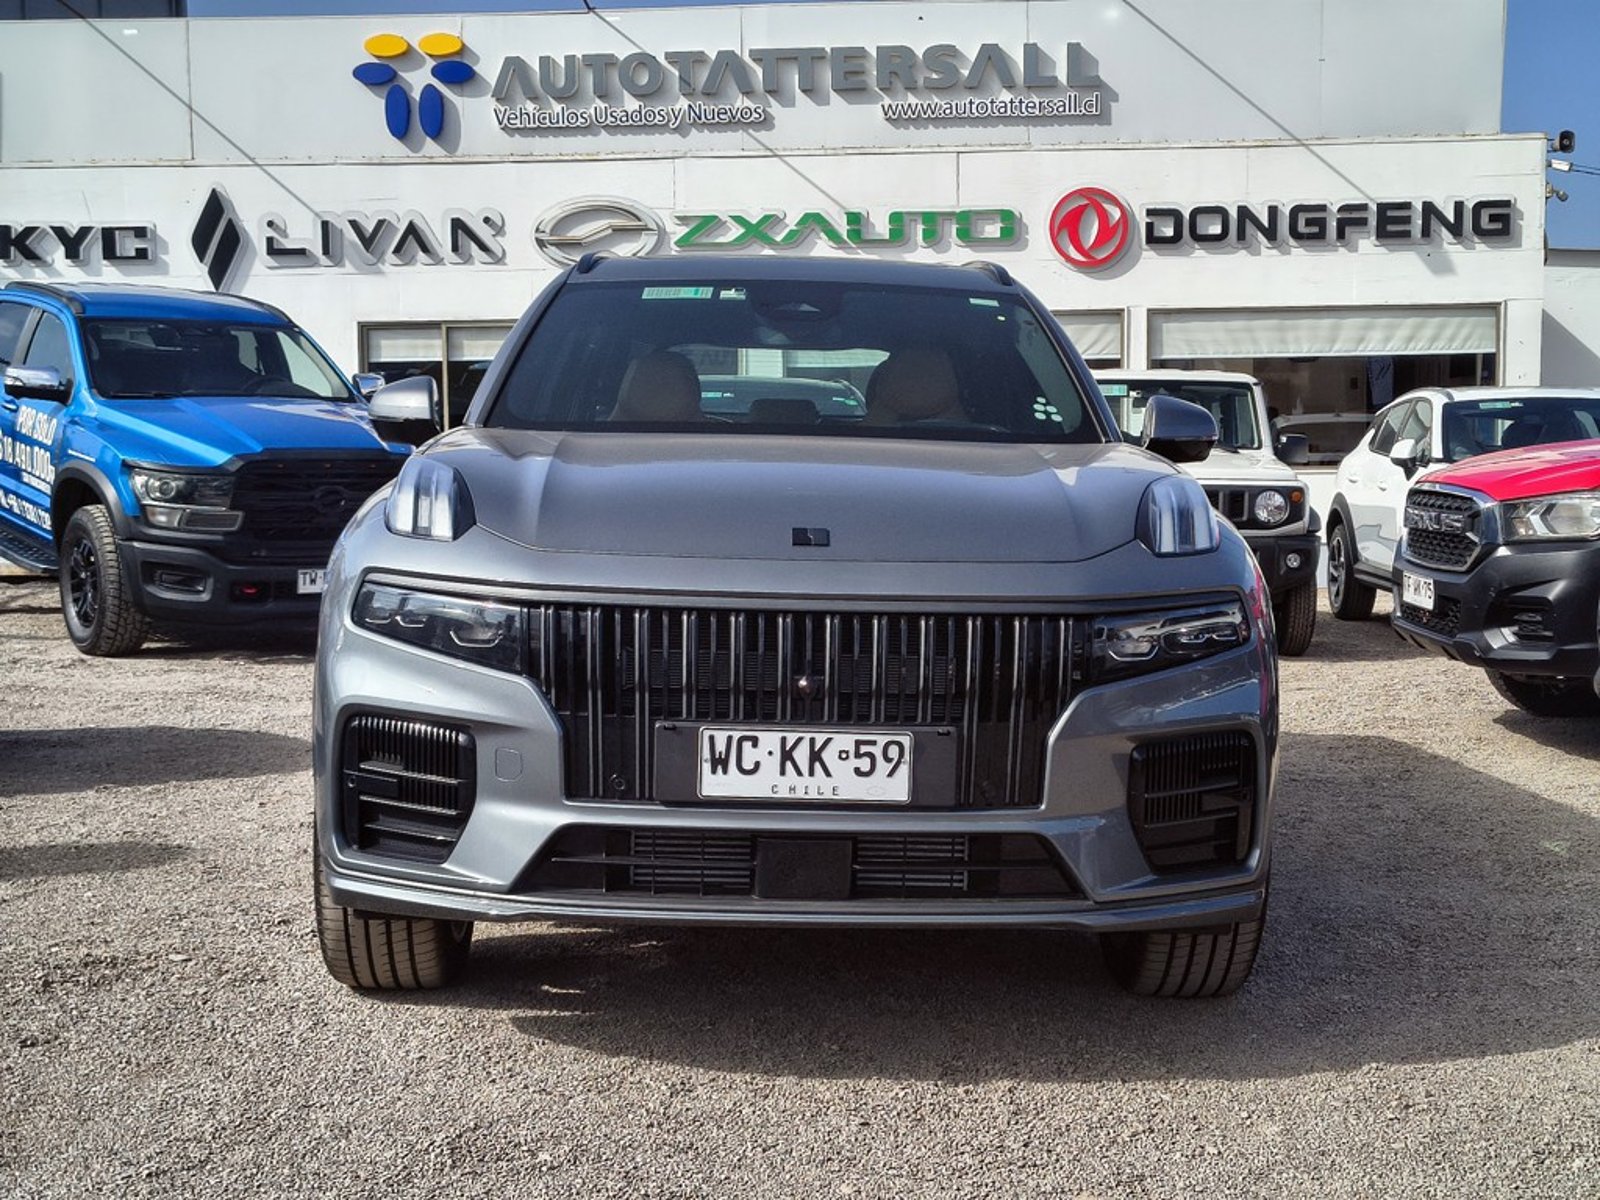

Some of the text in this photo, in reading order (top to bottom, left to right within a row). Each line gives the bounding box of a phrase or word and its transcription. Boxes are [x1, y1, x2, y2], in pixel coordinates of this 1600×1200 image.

[491, 42, 1101, 99] AUTOTATTERSALL
[494, 103, 764, 128] Vehículos Usados y Nuevos
[881, 93, 1099, 118] www.autotattersall.cl
[266, 215, 502, 256] LIVAN
[674, 209, 1016, 248] ZXAUTO
[1145, 199, 1512, 245] DONGFENG
[0, 225, 150, 260] KYC
[771, 784, 840, 796] CHILE
